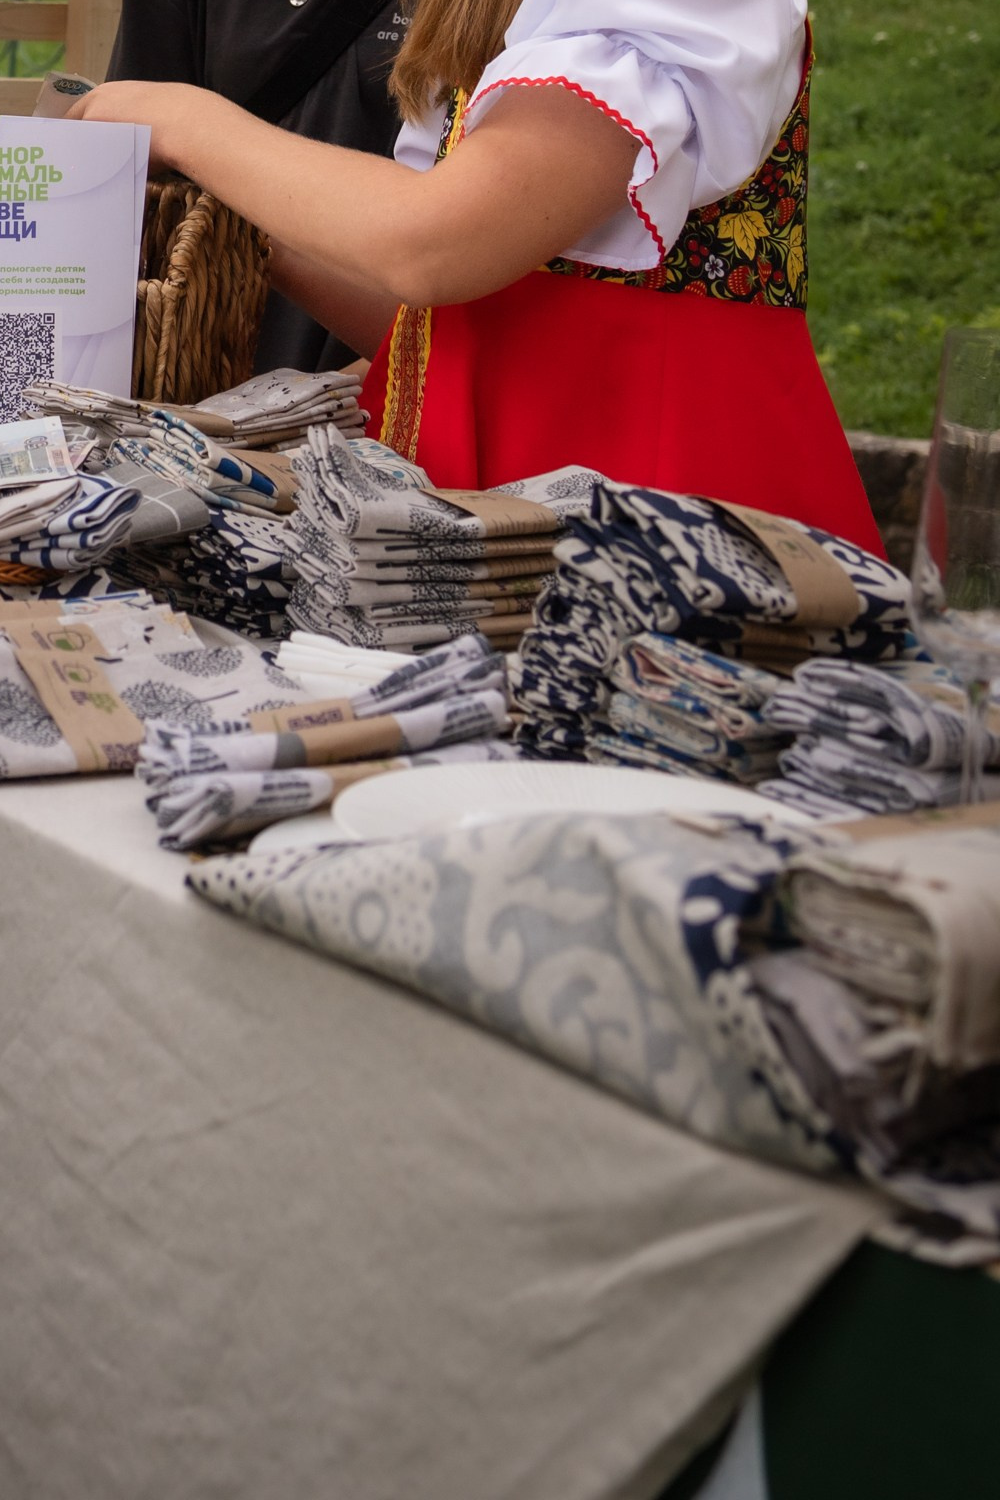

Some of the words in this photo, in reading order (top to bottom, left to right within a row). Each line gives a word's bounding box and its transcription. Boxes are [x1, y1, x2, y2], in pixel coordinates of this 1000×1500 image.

[377, 30, 399, 41] are
[59, 80, 82, 90] 1000
[0, 266, 52, 274] помогаете
[54, 266, 86, 274] детям
[0, 276, 23, 284] себя
[35, 277, 86, 285] создавать
[58, 288, 86, 296] вещи
